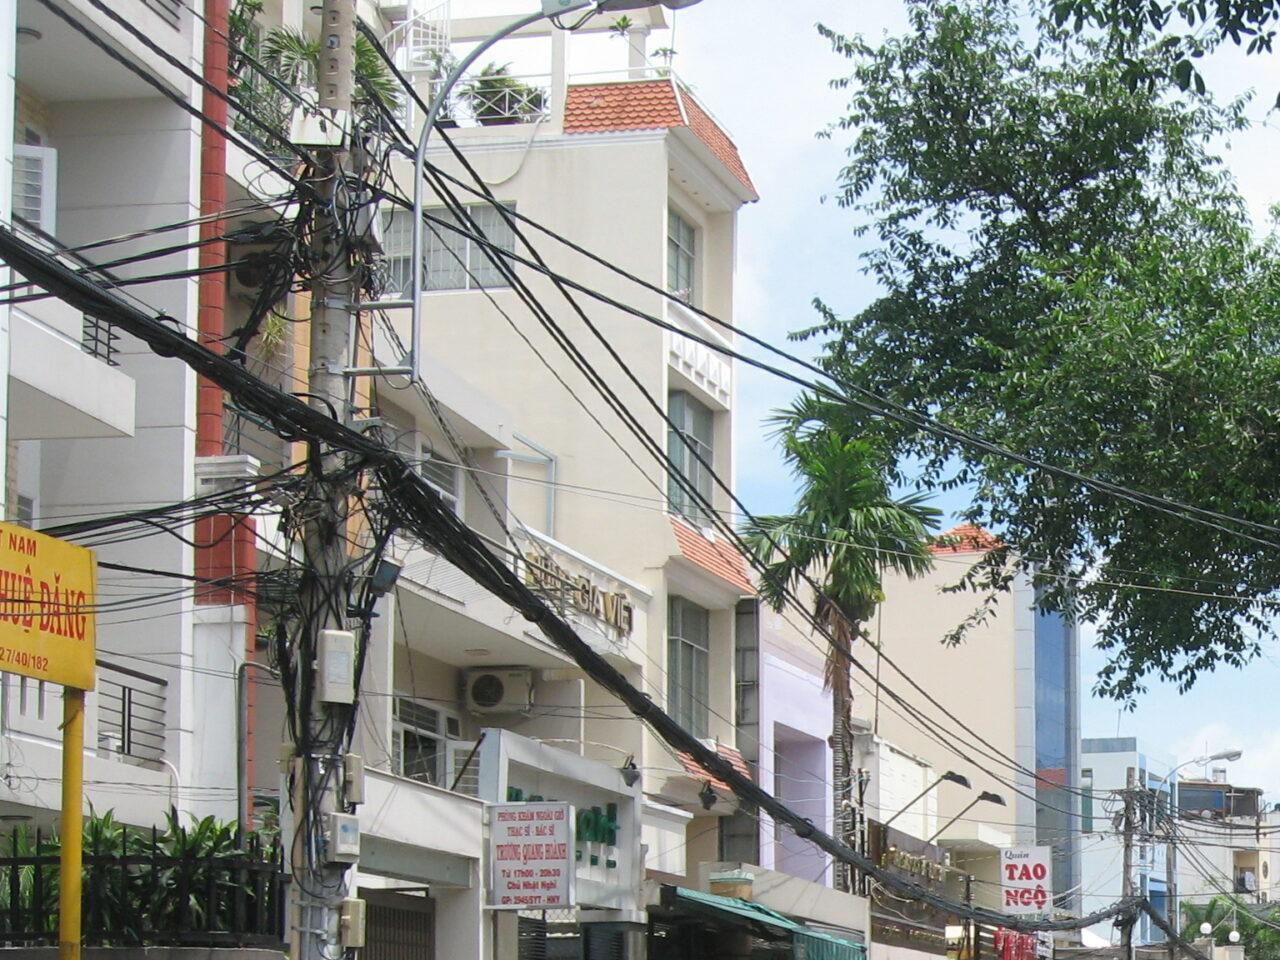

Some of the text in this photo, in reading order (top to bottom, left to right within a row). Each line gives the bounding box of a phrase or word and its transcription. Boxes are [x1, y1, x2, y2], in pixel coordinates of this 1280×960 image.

[9, 533, 37, 558] NAM
[40, 572, 87, 641] ĐĂNG
[1005, 851, 1030, 861] Quán
[1005, 864, 1047, 881] TAO
[1005, 885, 1047, 910] NGỘ
